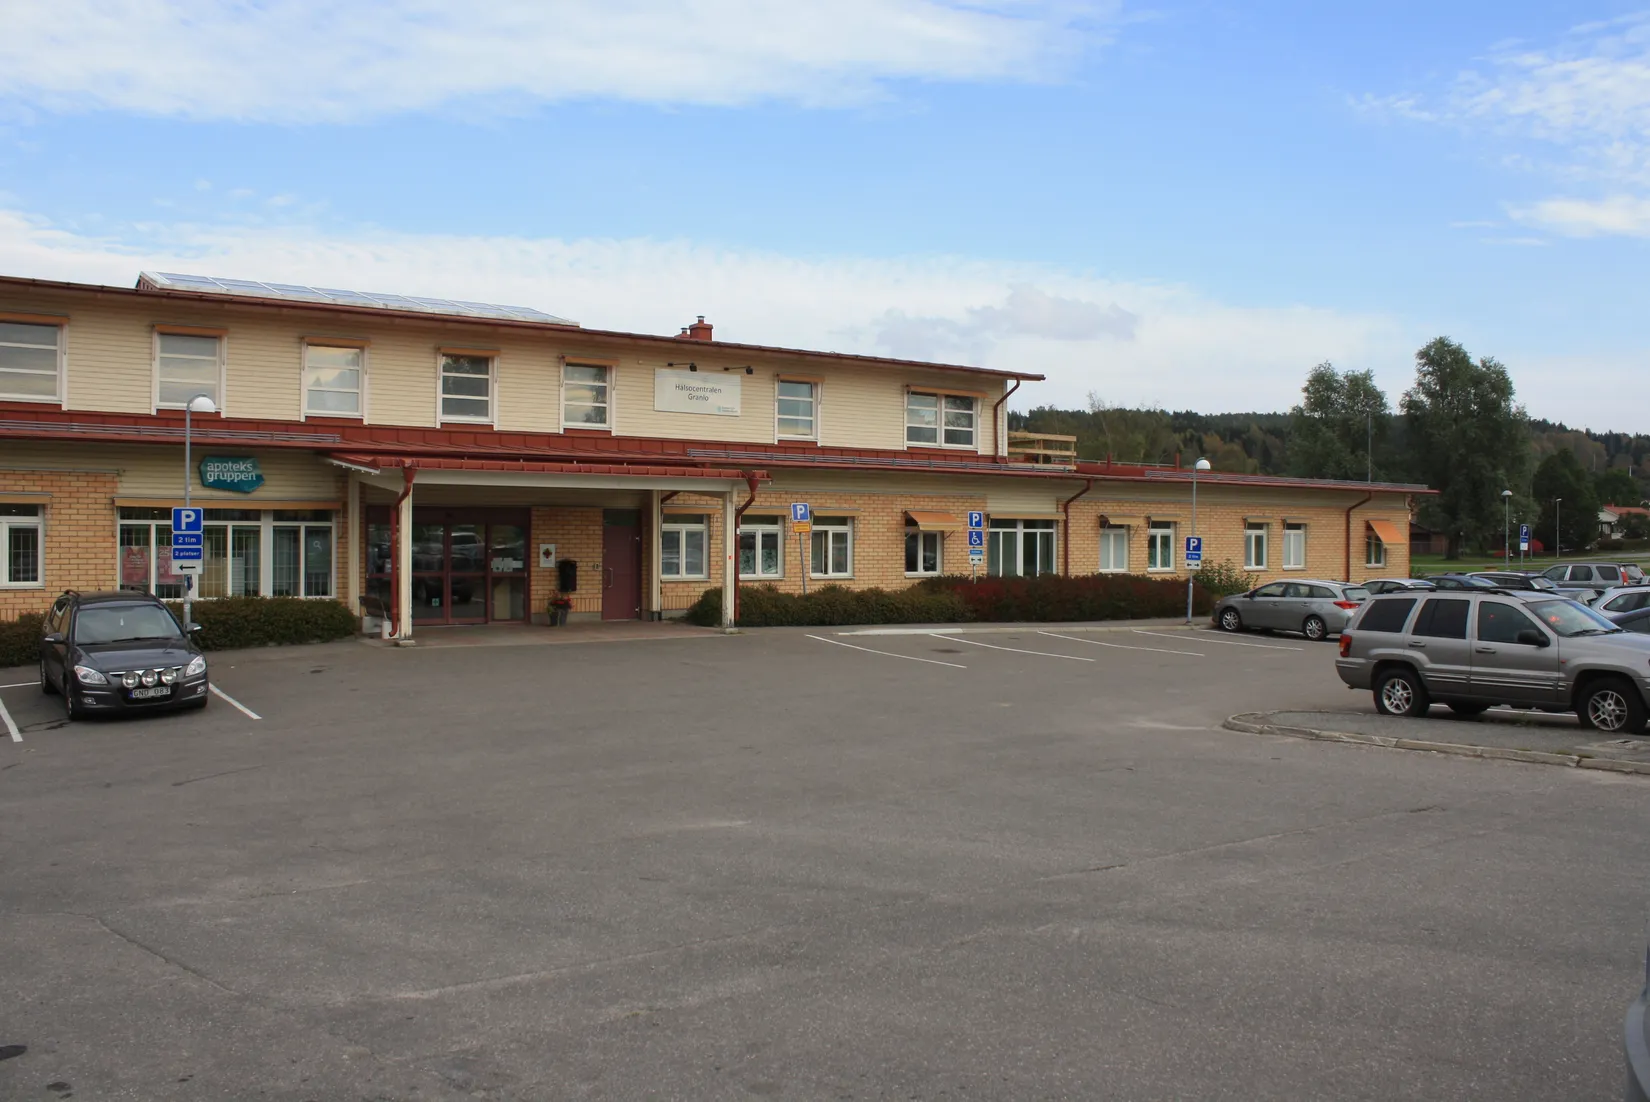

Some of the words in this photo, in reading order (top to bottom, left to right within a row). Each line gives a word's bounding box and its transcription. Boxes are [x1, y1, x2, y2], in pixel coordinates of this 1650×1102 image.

[207, 462, 253, 473] apoteks
[207, 472, 256, 482] gruppen
[797, 505, 805, 520] P
[181, 510, 196, 530] P
[972, 513, 980, 527] P
[1190, 538, 1198, 551] P
[180, 550, 200, 558] platser
